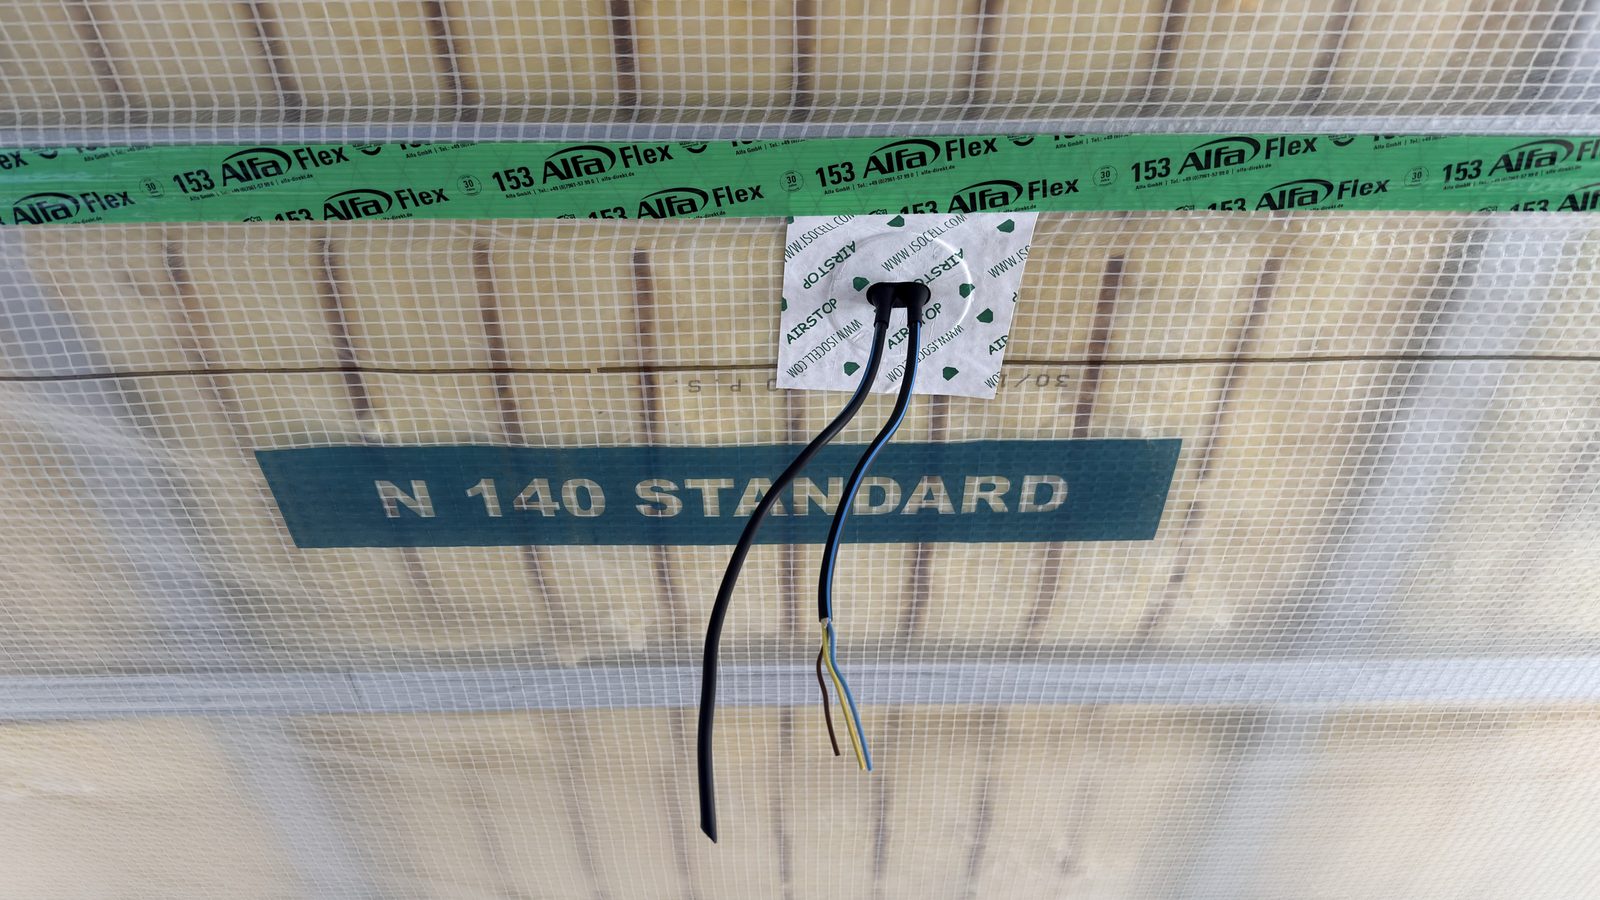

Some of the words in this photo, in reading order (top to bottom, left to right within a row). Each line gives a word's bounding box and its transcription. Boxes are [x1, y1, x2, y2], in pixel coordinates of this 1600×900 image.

[173, 168, 215, 194] 153
[221, 158, 284, 186] Alfa
[292, 145, 350, 171] Flex
[492, 166, 534, 192] 153
[542, 154, 606, 184] Alfa
[618, 144, 674, 169] Flex
[815, 161, 856, 188] 153
[862, 149, 928, 178] Alfa
[945, 137, 998, 162] Flex
[1100, 170, 1110, 179] 30
[1131, 157, 1171, 183] 153
[1178, 146, 1246, 176] Alfa
[1265, 136, 1318, 160] Flex
[1412, 171, 1422, 180] 30
[1442, 159, 1483, 183] 153
[1488, 148, 1557, 177] Alfa
[146, 182, 156, 192] 30
[463, 180, 474, 189] 30
[786, 174, 796, 184] 30
[947, 190, 1011, 214] Alfa
[1028, 178, 1079, 201] Flex
[1255, 186, 1318, 210] Alfa
[1338, 178, 1390, 200] Flex
[12, 201, 74, 224] Alfa
[81, 190, 136, 213] Flex
[323, 197, 384, 220] Alfa
[394, 187, 450, 210] Flex
[637, 195, 698, 219] Alfa
[712, 185, 764, 208] Flex
[881, 214, 967, 272] WWW.ISOCELL.COM
[803, 240, 856, 290] AIRSTOP
[914, 248, 964, 285] AIRST
[786, 298, 837, 344] AIRSTOP
[888, 303, 942, 350] AIROP
[786, 319, 863, 378] WWW.ISOCELL.COM
[886, 324, 964, 382] WWW.ISOC.COM
[374, 479, 436, 518] N
[465, 478, 606, 518] 140
[634, 475, 1068, 518] STANDARD
